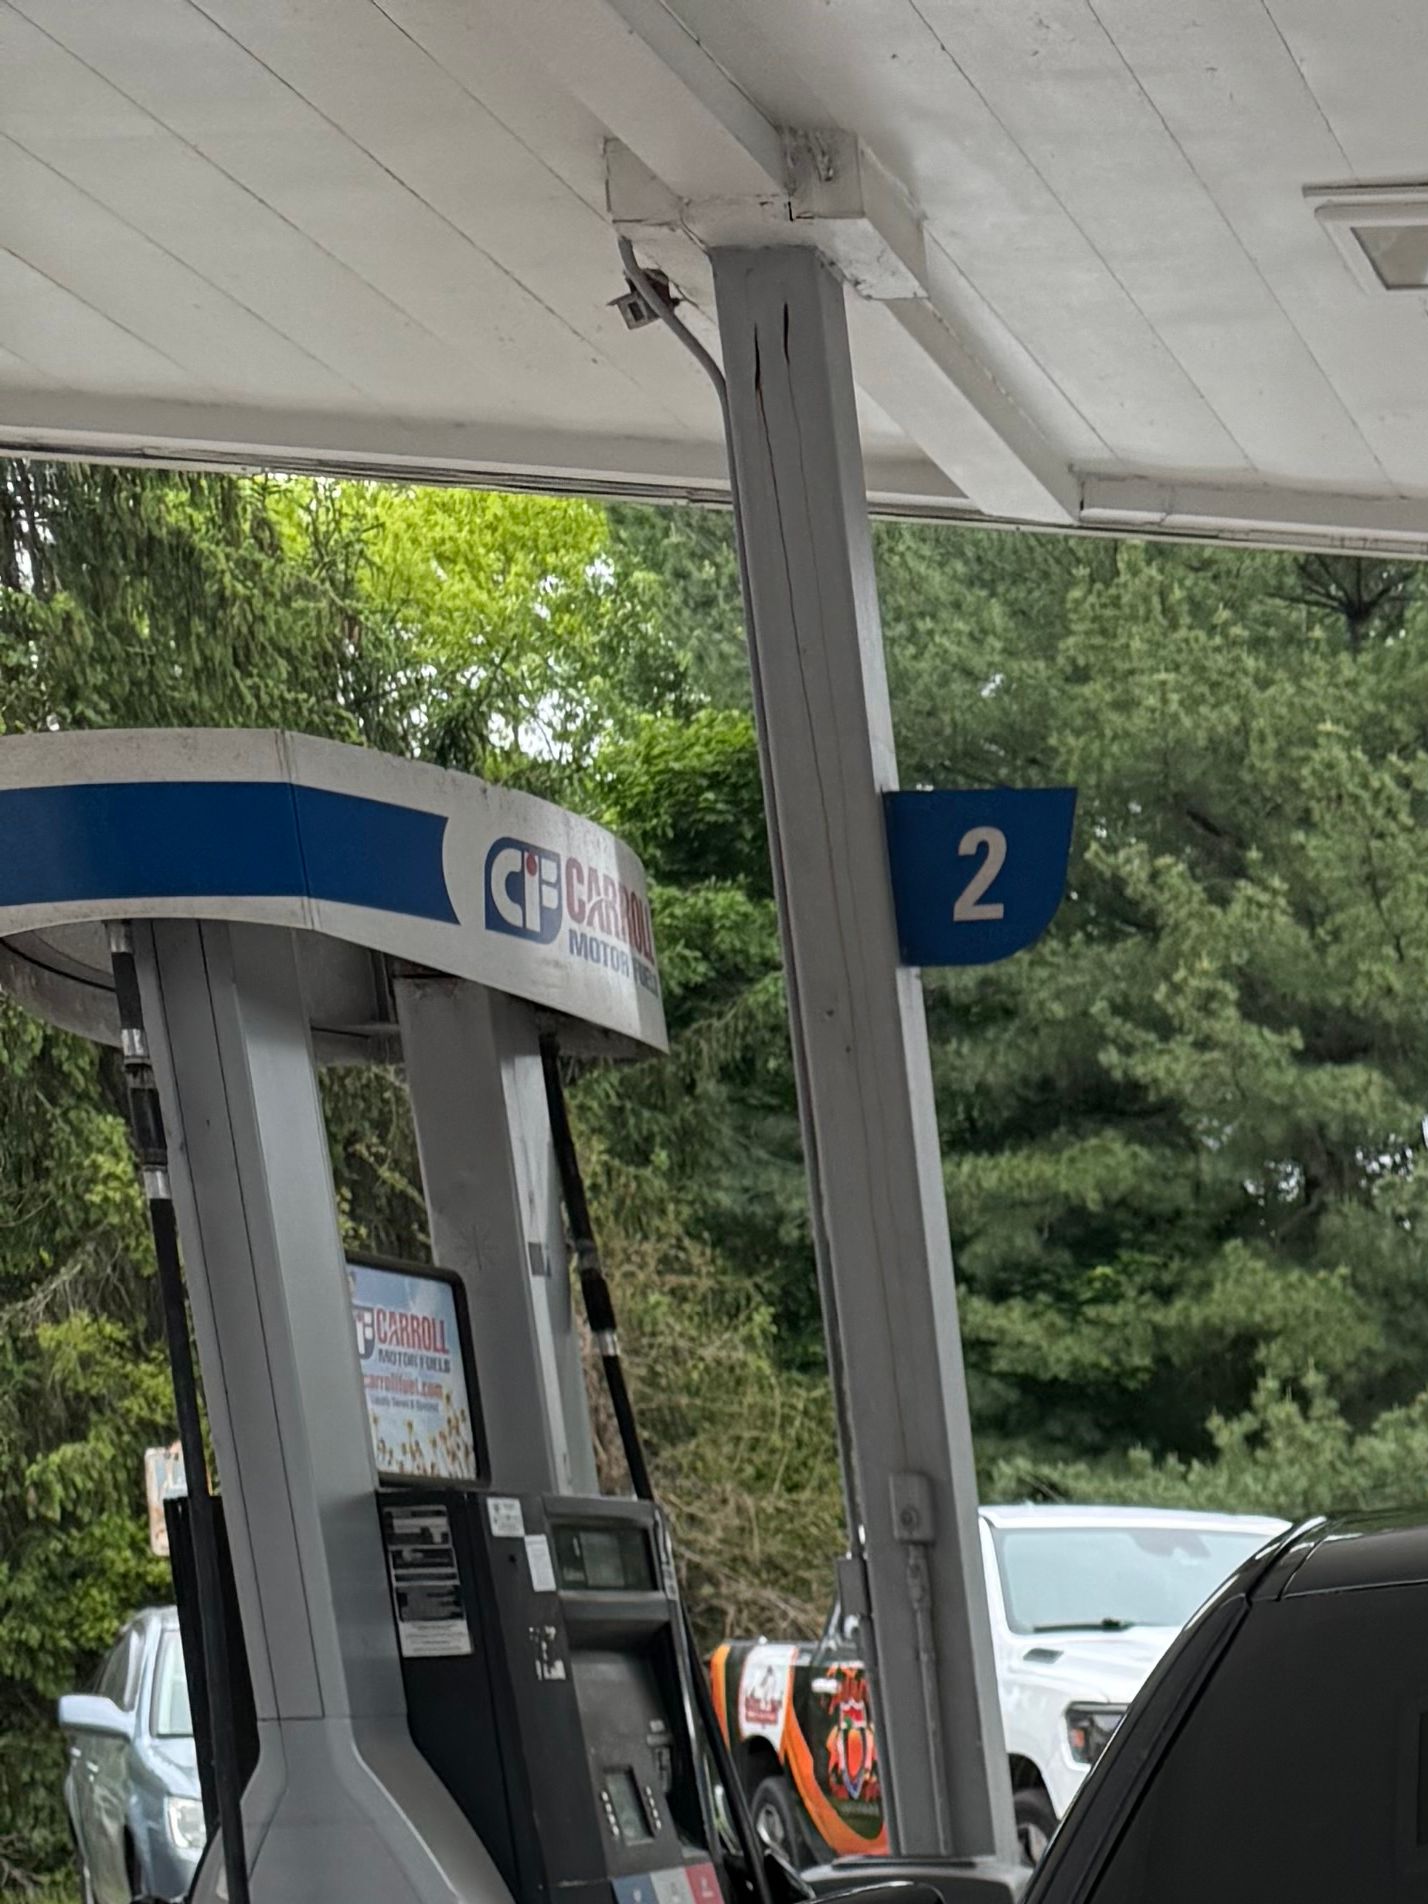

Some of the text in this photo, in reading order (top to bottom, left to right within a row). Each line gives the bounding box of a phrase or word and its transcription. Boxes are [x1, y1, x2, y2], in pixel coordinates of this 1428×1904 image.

[953, 826, 1007, 921] 2
[568, 928, 630, 977] MOTOR
[376, 1308, 449, 1354] CARROLL
